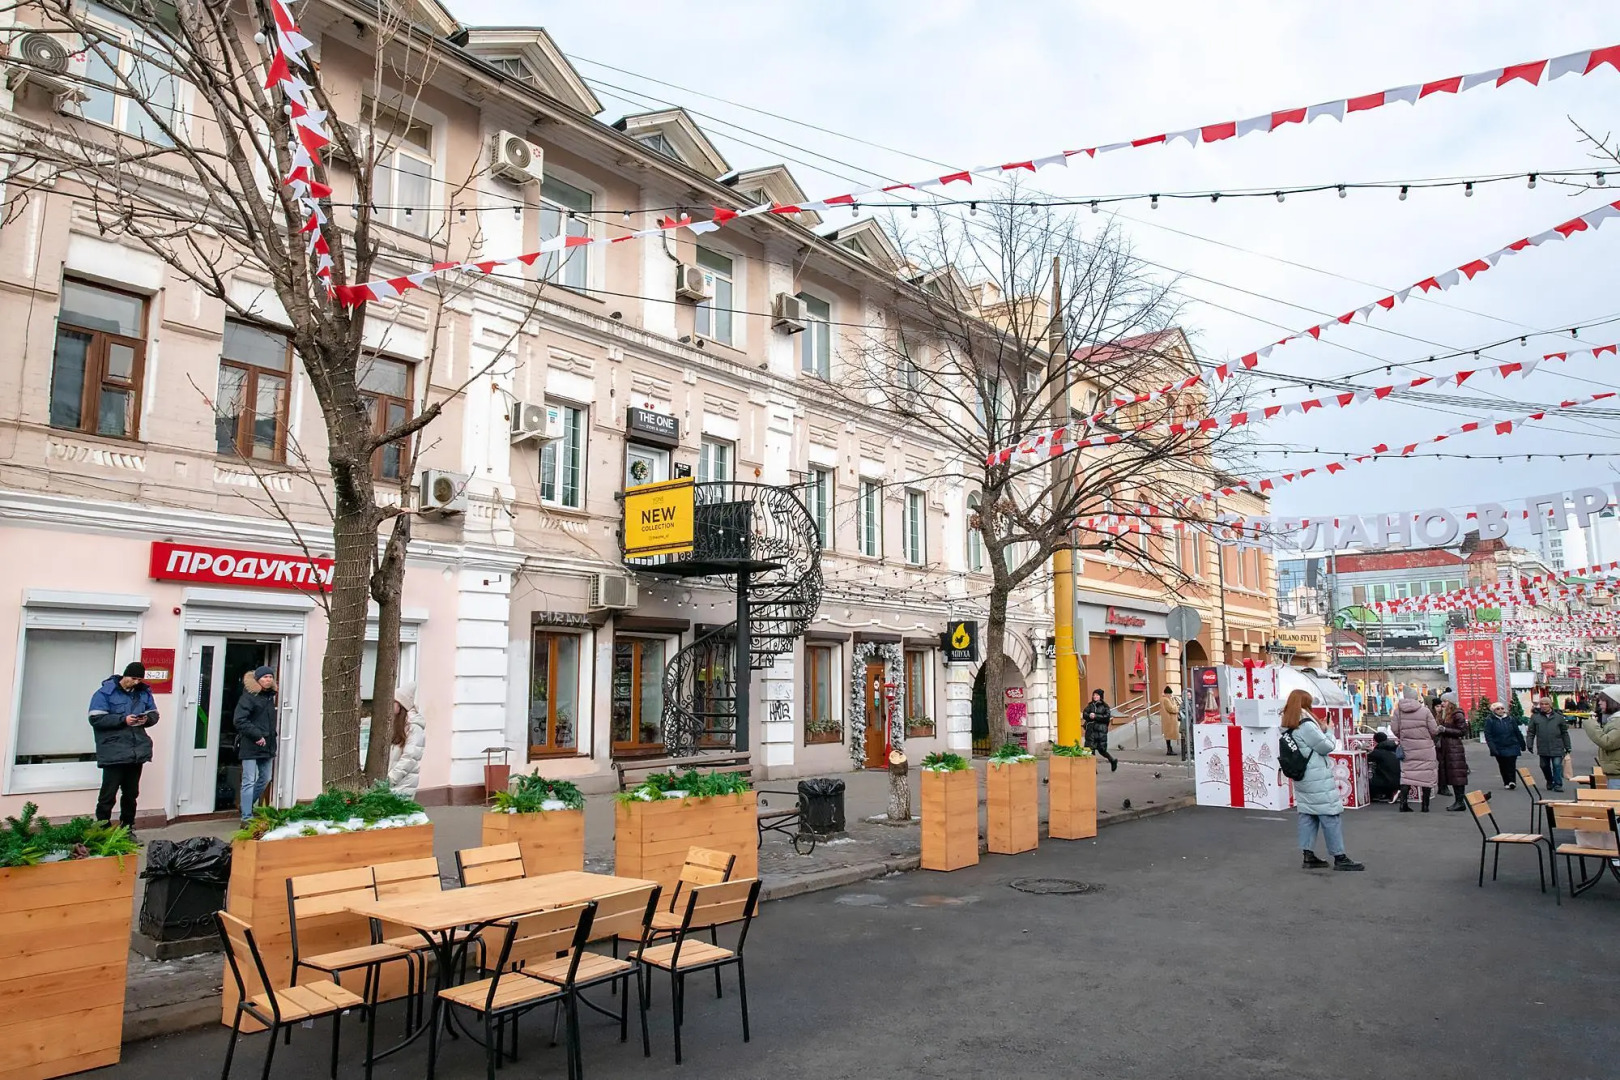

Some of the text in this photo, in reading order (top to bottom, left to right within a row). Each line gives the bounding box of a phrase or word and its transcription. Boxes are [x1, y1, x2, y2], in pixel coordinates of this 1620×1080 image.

[638, 410, 656, 425] THE
[656, 415, 675, 430] ONE
[641, 505, 676, 525] NEW
[1475, 502, 1510, 541] В
[1525, 481, 1620, 535] ПР
[641, 522, 675, 532] COLLECTION
[166, 550, 335, 585] ПРОДУКТЫ
[1278, 634, 1318, 643] MILANO STYLE
[1418, 638, 1438, 646] TELE2
[146, 671, 165, 679] 8-21
